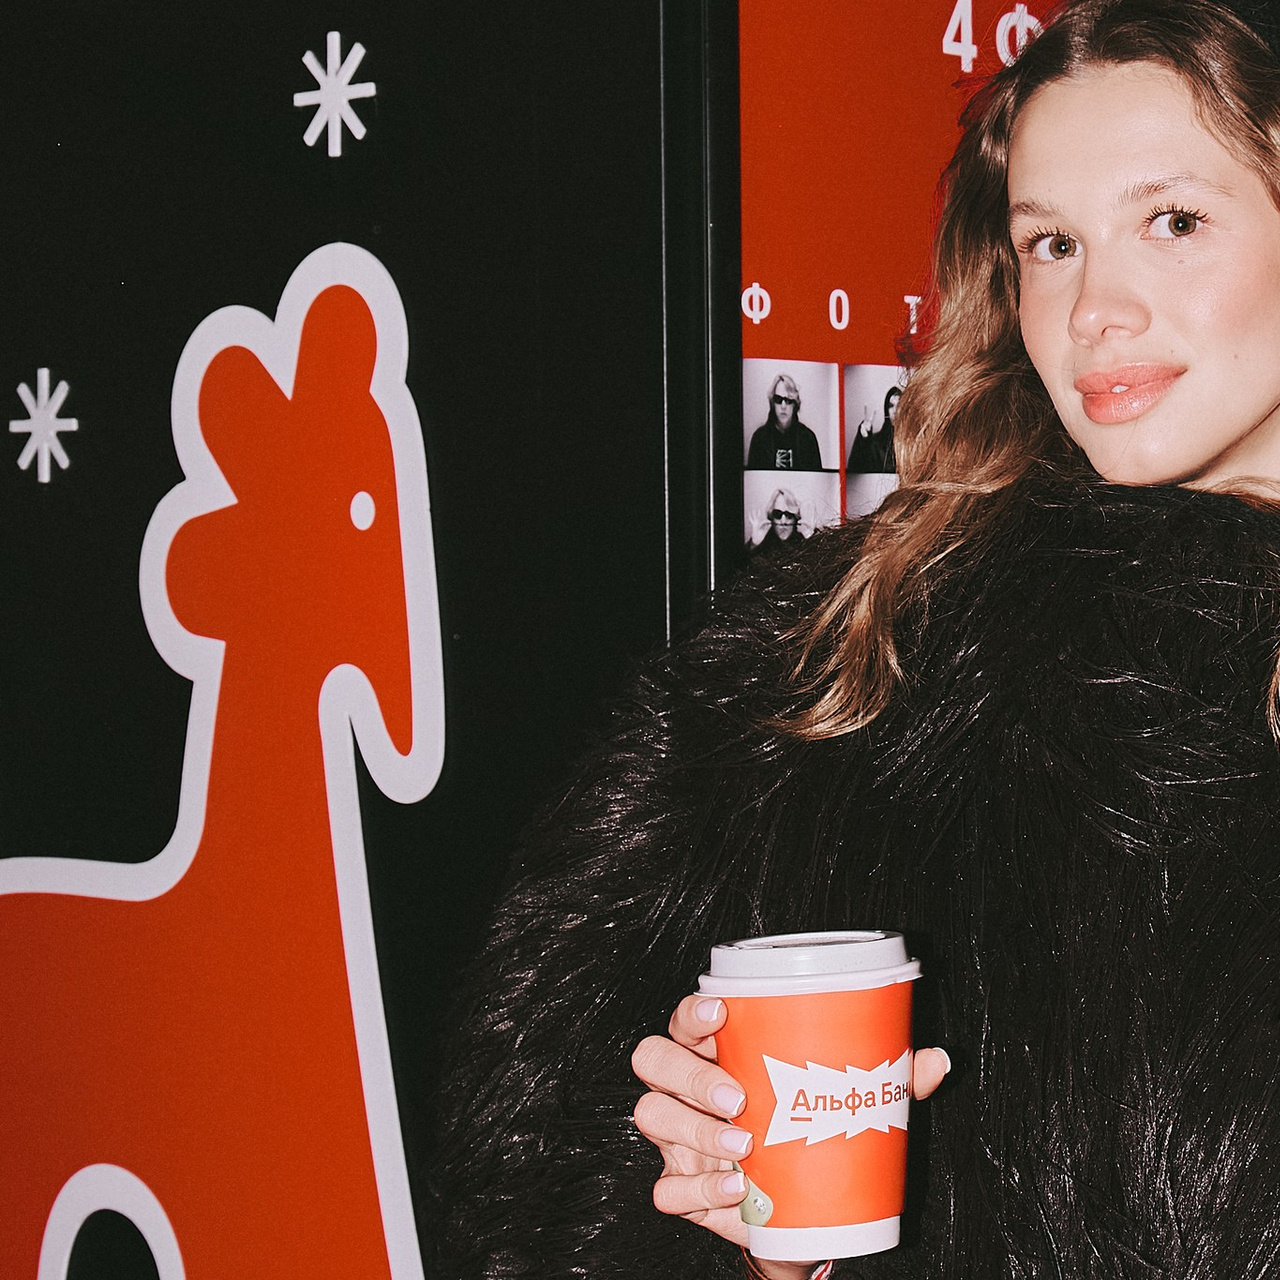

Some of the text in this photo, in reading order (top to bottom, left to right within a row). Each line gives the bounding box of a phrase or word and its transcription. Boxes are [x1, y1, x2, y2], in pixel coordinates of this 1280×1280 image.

[741, 281, 923, 335] ФОТ
[791, 1081, 912, 1116] Альфа Бан
